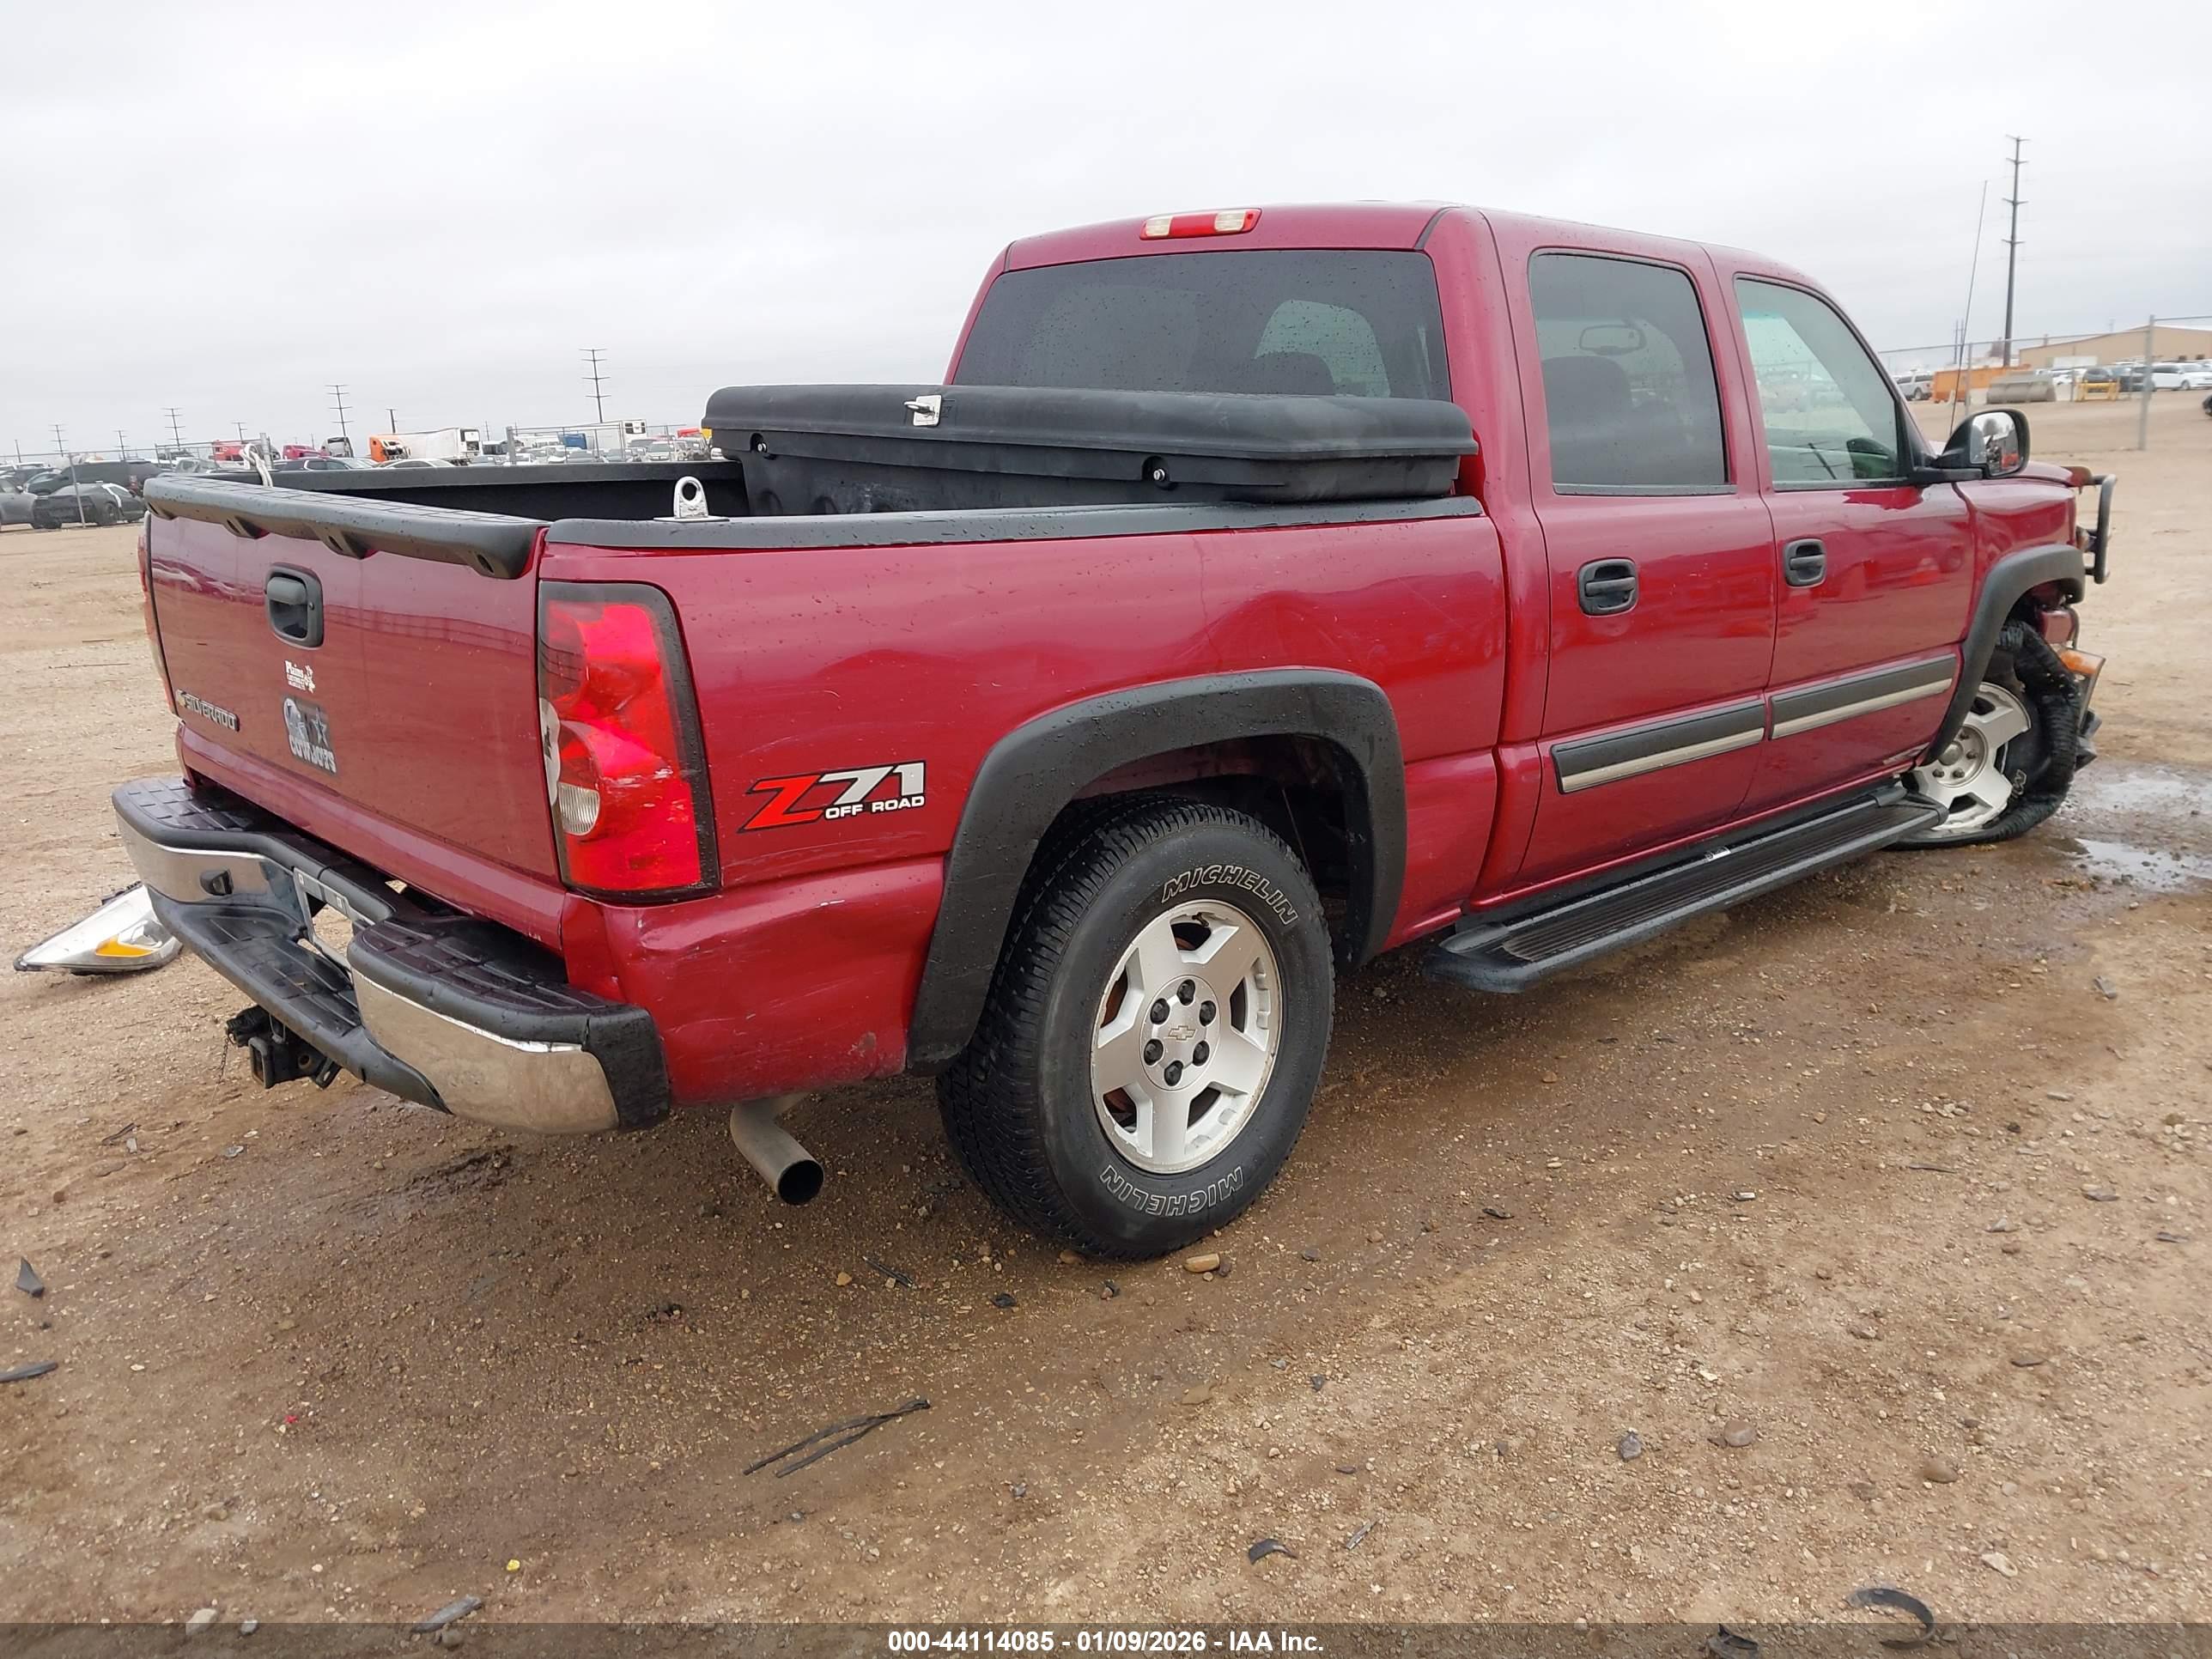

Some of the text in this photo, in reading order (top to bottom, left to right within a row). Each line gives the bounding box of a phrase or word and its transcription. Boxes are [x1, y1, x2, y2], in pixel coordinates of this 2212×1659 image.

[184, 696, 236, 731] SILVERADO
[289, 734, 337, 774] COWBOYS
[738, 760, 926, 834] Z71
[824, 795, 926, 820] OFF ROAD
[1161, 864, 1299, 926] MICHELIN
[1099, 1164, 1244, 1218] MICHELIN
